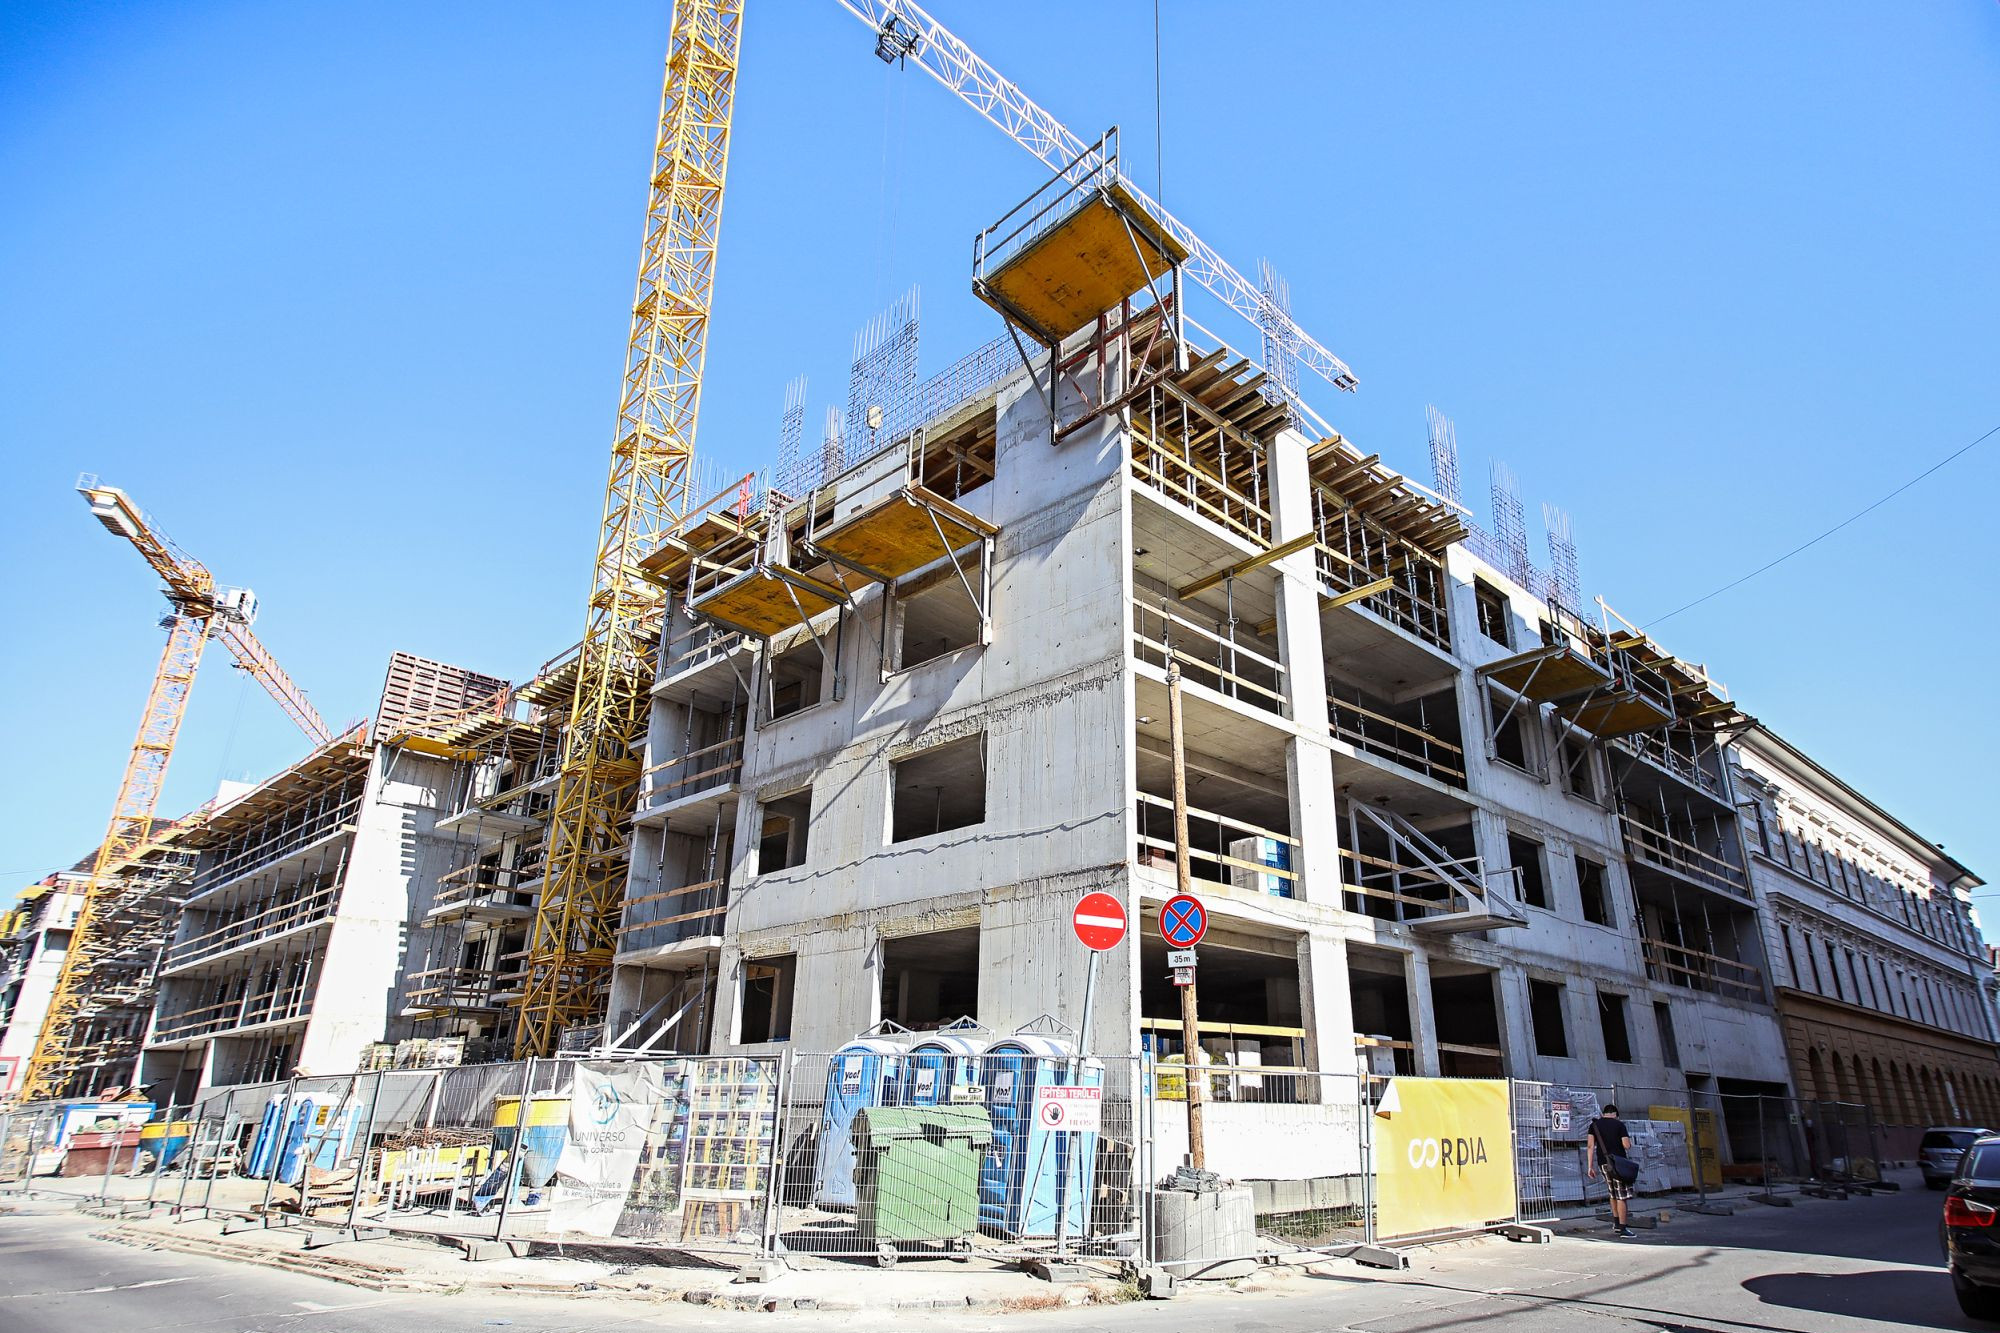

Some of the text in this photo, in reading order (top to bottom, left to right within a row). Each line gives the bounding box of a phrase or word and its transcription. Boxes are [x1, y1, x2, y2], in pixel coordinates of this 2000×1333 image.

[1174, 955, 1183, 963] 35
[844, 1069, 861, 1082] yoo!
[916, 1081, 932, 1093] yoo!
[995, 1085, 1011, 1098] yoo!
[575, 1131, 626, 1142] UNIVERSO
[1408, 1136, 1487, 1169] CORDIA
